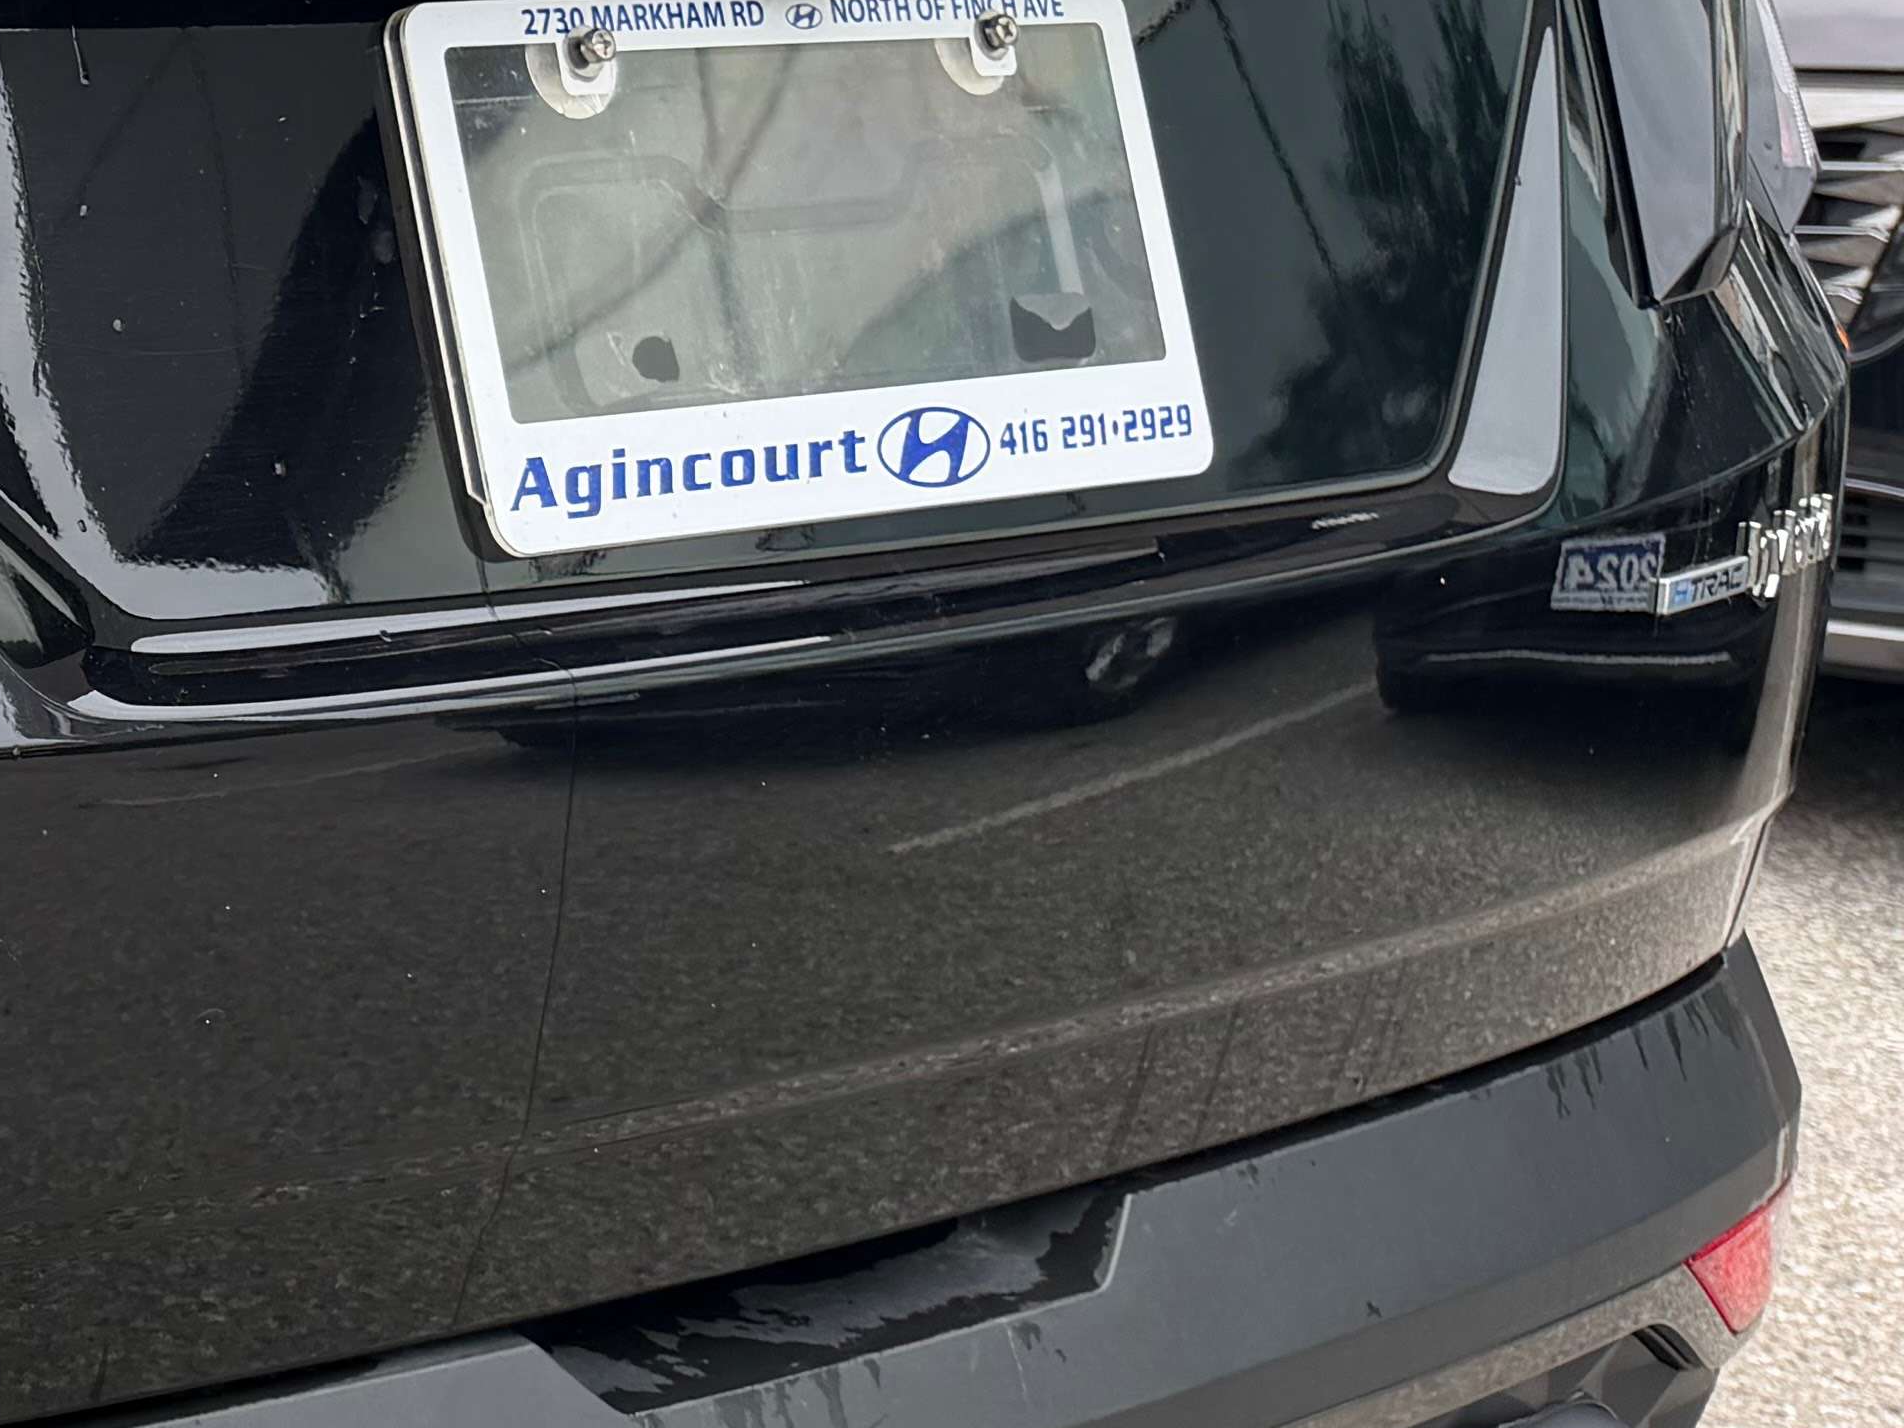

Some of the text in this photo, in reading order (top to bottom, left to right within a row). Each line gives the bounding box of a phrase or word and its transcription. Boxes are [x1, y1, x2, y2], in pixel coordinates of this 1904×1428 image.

[521, 0, 764, 35] 2730 MARKHAM RD
[999, 419, 1048, 456] 416
[510, 429, 868, 519] Agincourt
[1672, 562, 1744, 605] HTRAC
